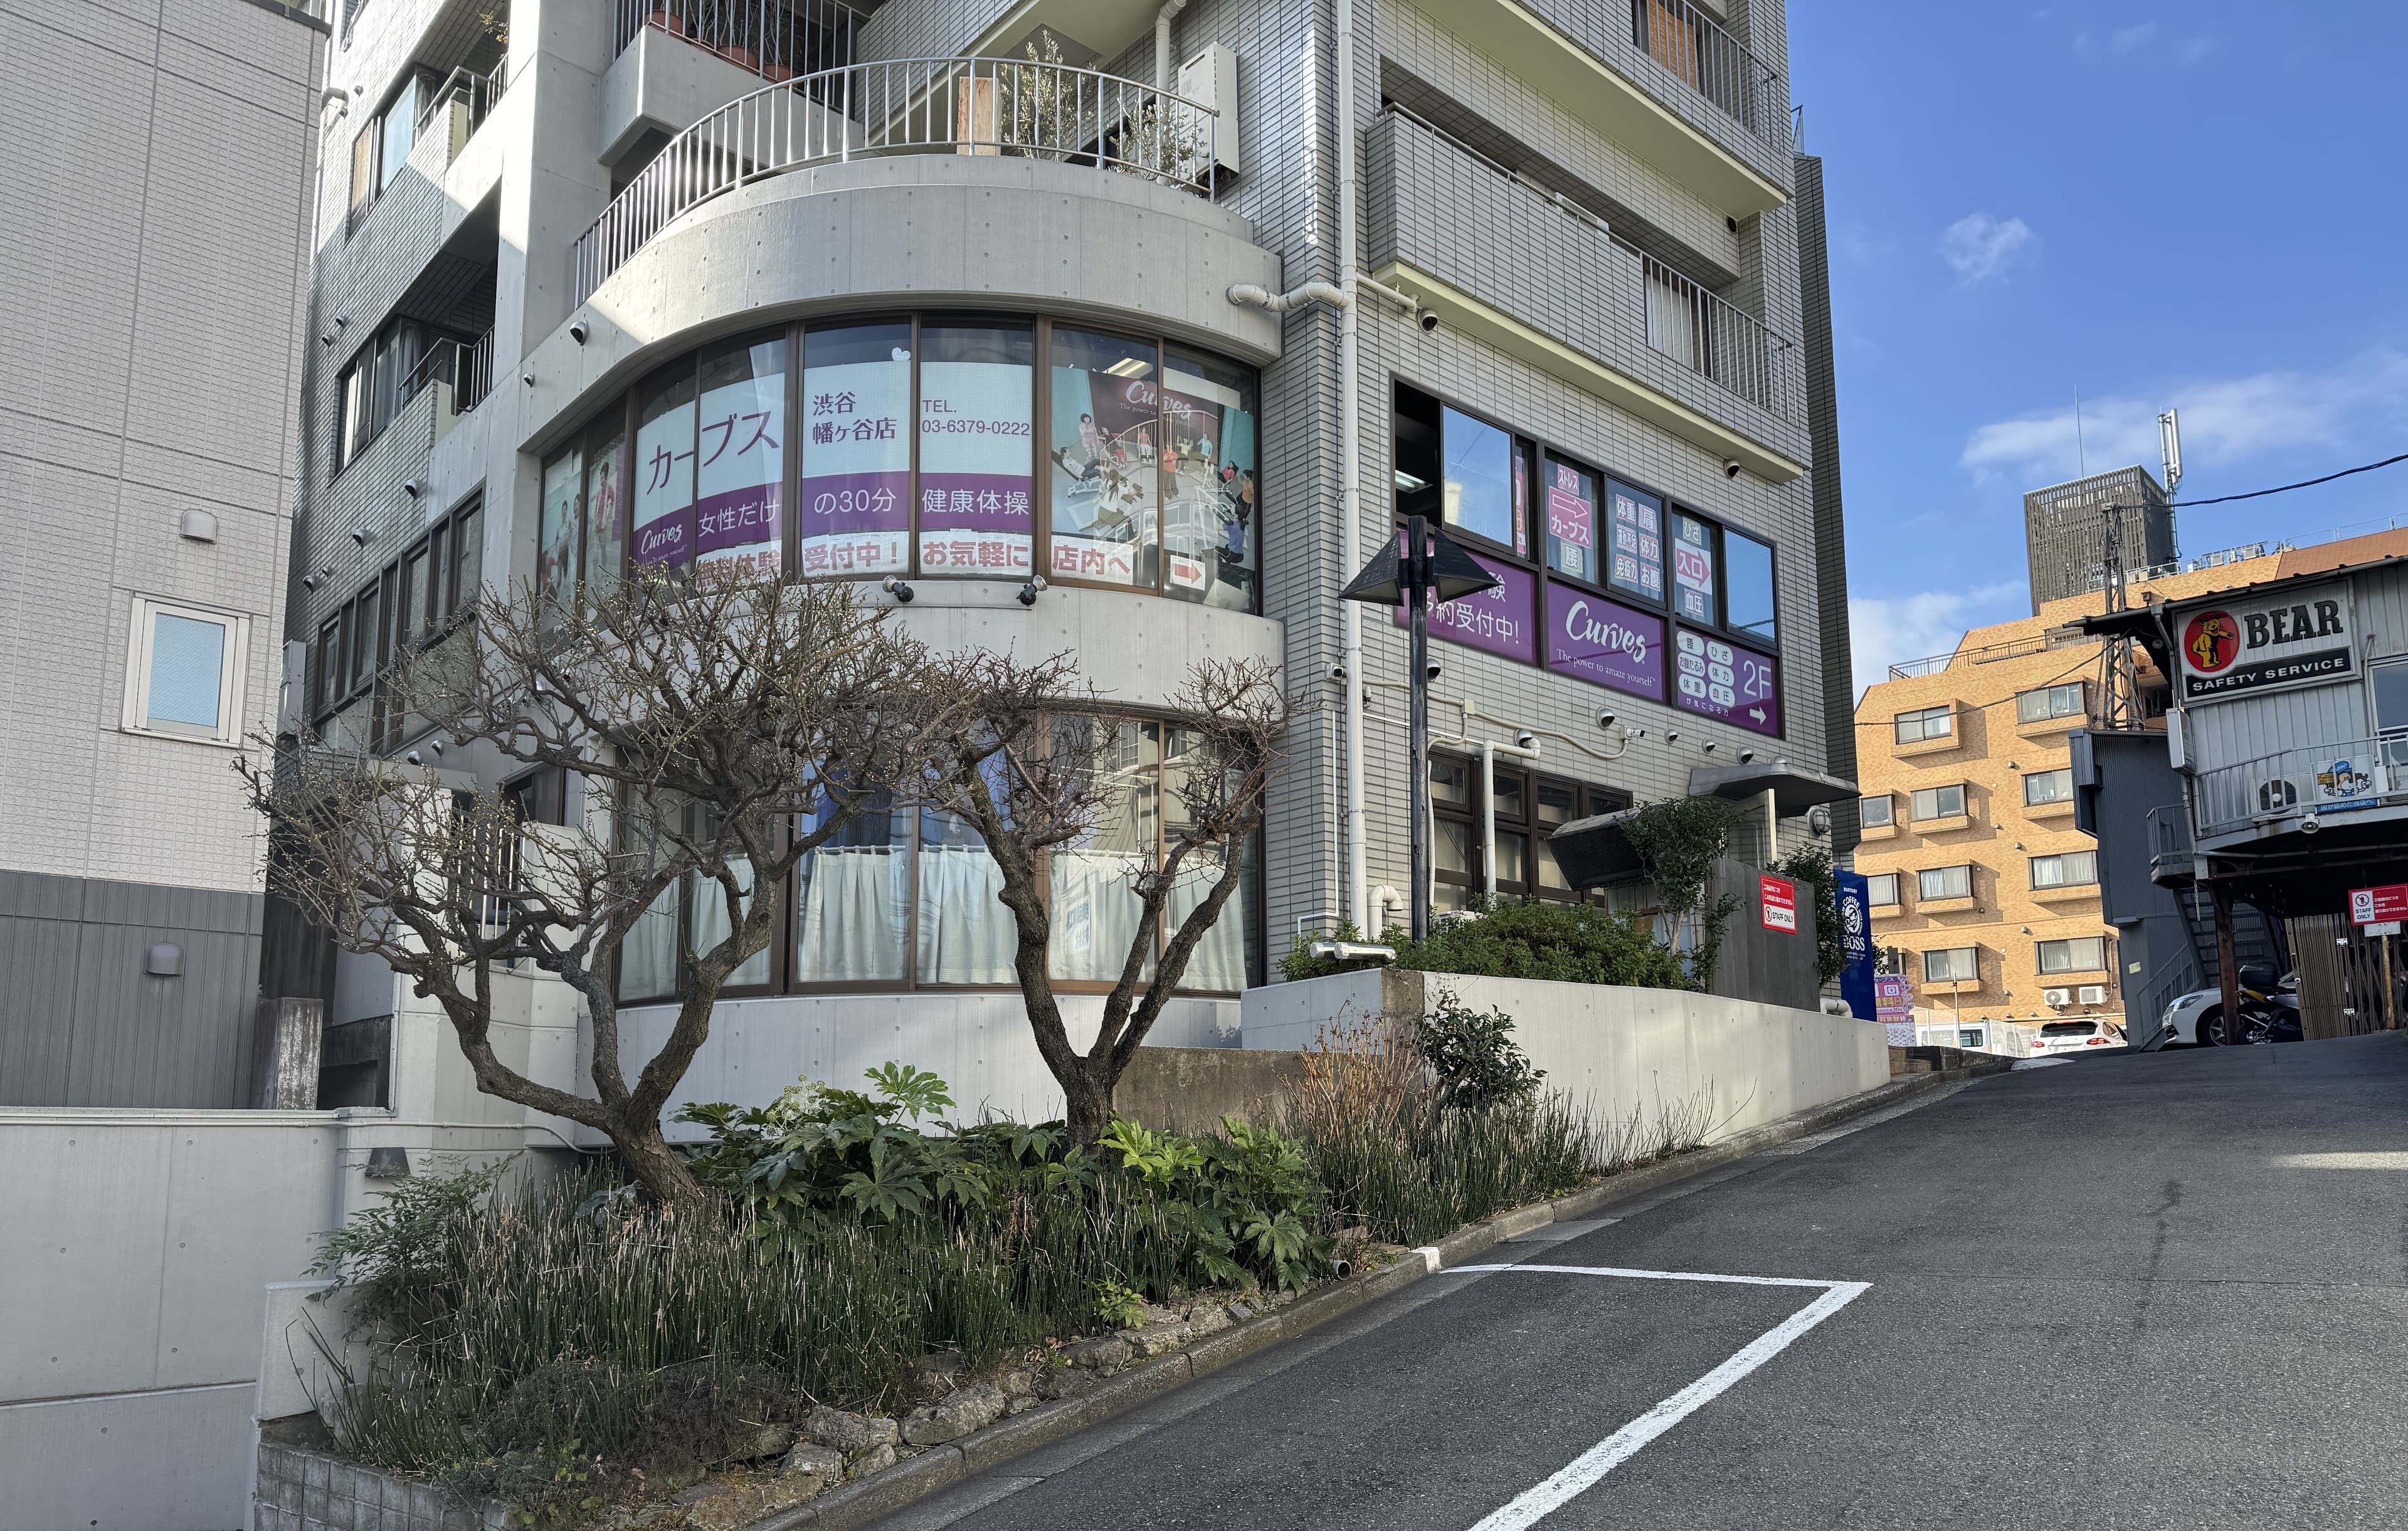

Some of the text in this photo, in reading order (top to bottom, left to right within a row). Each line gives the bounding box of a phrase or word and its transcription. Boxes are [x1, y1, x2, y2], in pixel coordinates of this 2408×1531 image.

[813, 391, 856, 416] 渋谷
[922, 400, 957, 413] TEL.
[813, 418, 897, 445] 幡ヶ谷店
[922, 420, 1030, 436] 03-6379-0222
[647, 411, 779, 495] カーブス
[1558, 469, 1578, 490] ストレス
[699, 488, 1030, 537] 女性だけ の30分 健康体操
[1617, 497, 1635, 522] 体重
[1643, 508, 1654, 530] 肩
[641, 523, 682, 555] Curves
[1551, 515, 1590, 544] カーブス
[1684, 521, 1701, 544] ひざ
[923, 541, 1030, 567] お気軽に
[1052, 545, 1131, 575] 店内へ
[1566, 545, 1578, 568] 腰
[1640, 538, 1659, 559] 体力
[1617, 558, 1637, 580] 免疫力
[1642, 566, 1660, 589] お腹
[1679, 552, 1703, 580] 入口
[1686, 592, 1703, 613] 血圧
[1566, 600, 1647, 663] Curves
[2244, 600, 2344, 650] BEAR
[1711, 646, 1728, 661] ひざ
[1556, 648, 1653, 687] The power to amaze yourself
[1712, 666, 1729, 681] 体力
[1743, 660, 1772, 699] 2F
[2193, 658, 2344, 691] SAFETY SERVICE
[1683, 678, 1701, 693] 体重
[1843, 896, 1860, 909] COFFEE
